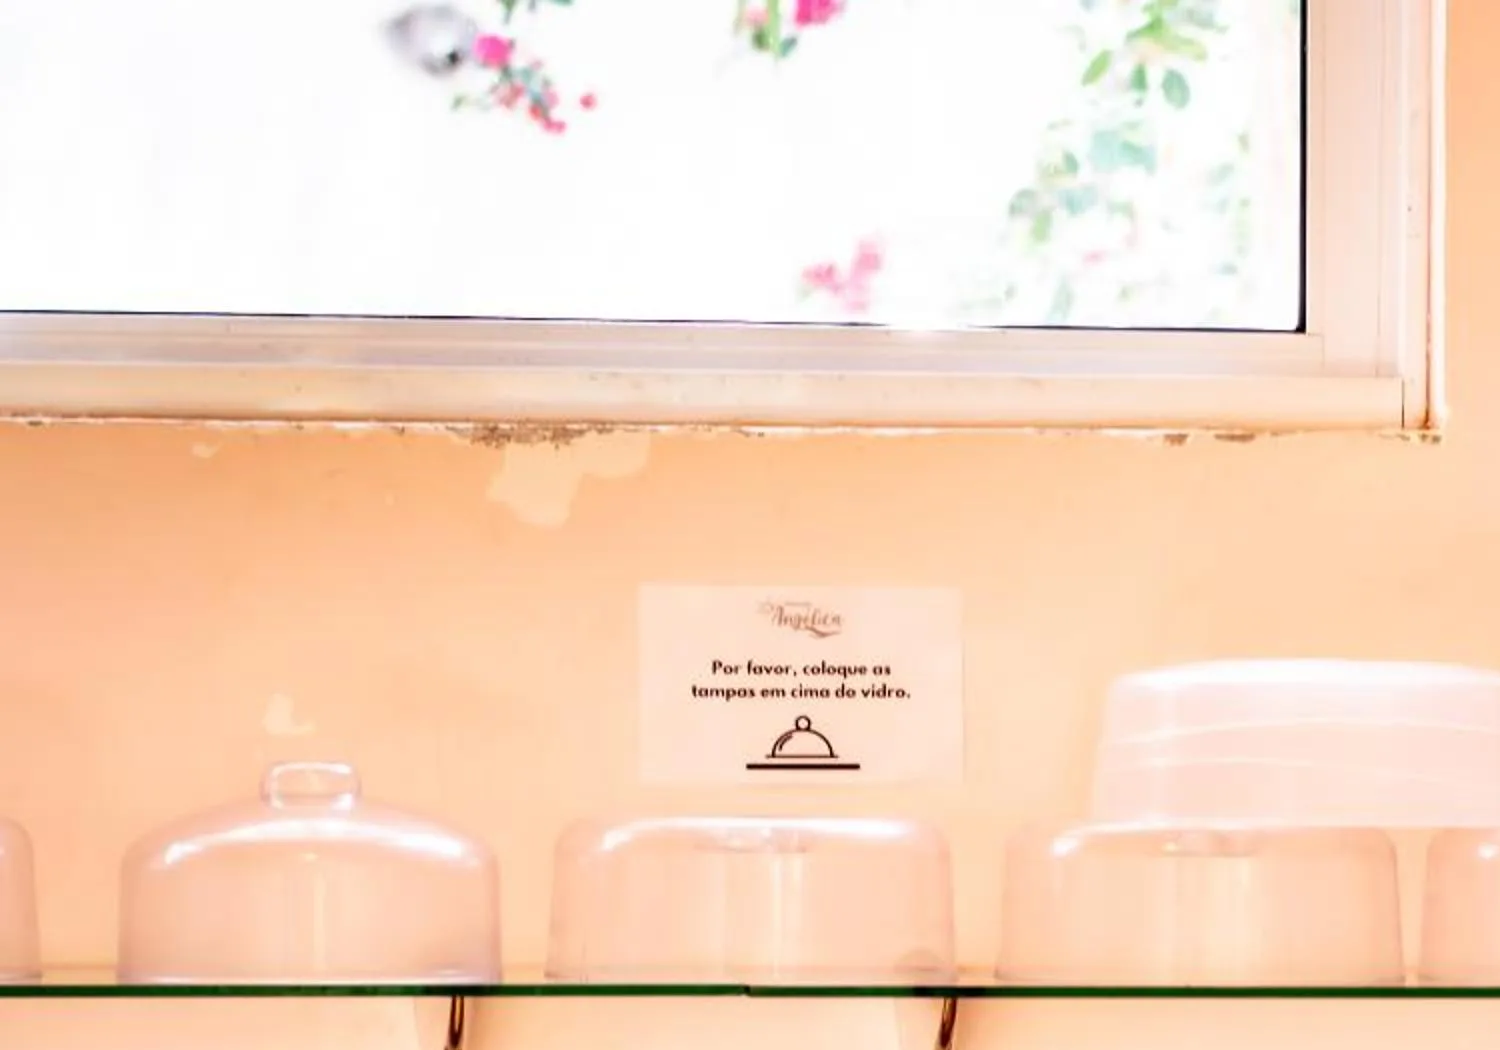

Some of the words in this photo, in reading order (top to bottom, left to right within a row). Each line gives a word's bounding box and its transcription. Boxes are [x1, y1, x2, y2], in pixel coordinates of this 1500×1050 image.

[711, 660, 741, 676] Por
[747, 660, 797, 677] favor,
[803, 660, 868, 679] coloque
[872, 665, 892, 676] as
[691, 684, 756, 700] tampas
[760, 687, 786, 698] em
[791, 683, 830, 698] cima
[835, 683, 856, 698] do
[861, 683, 911, 698] vidro.
